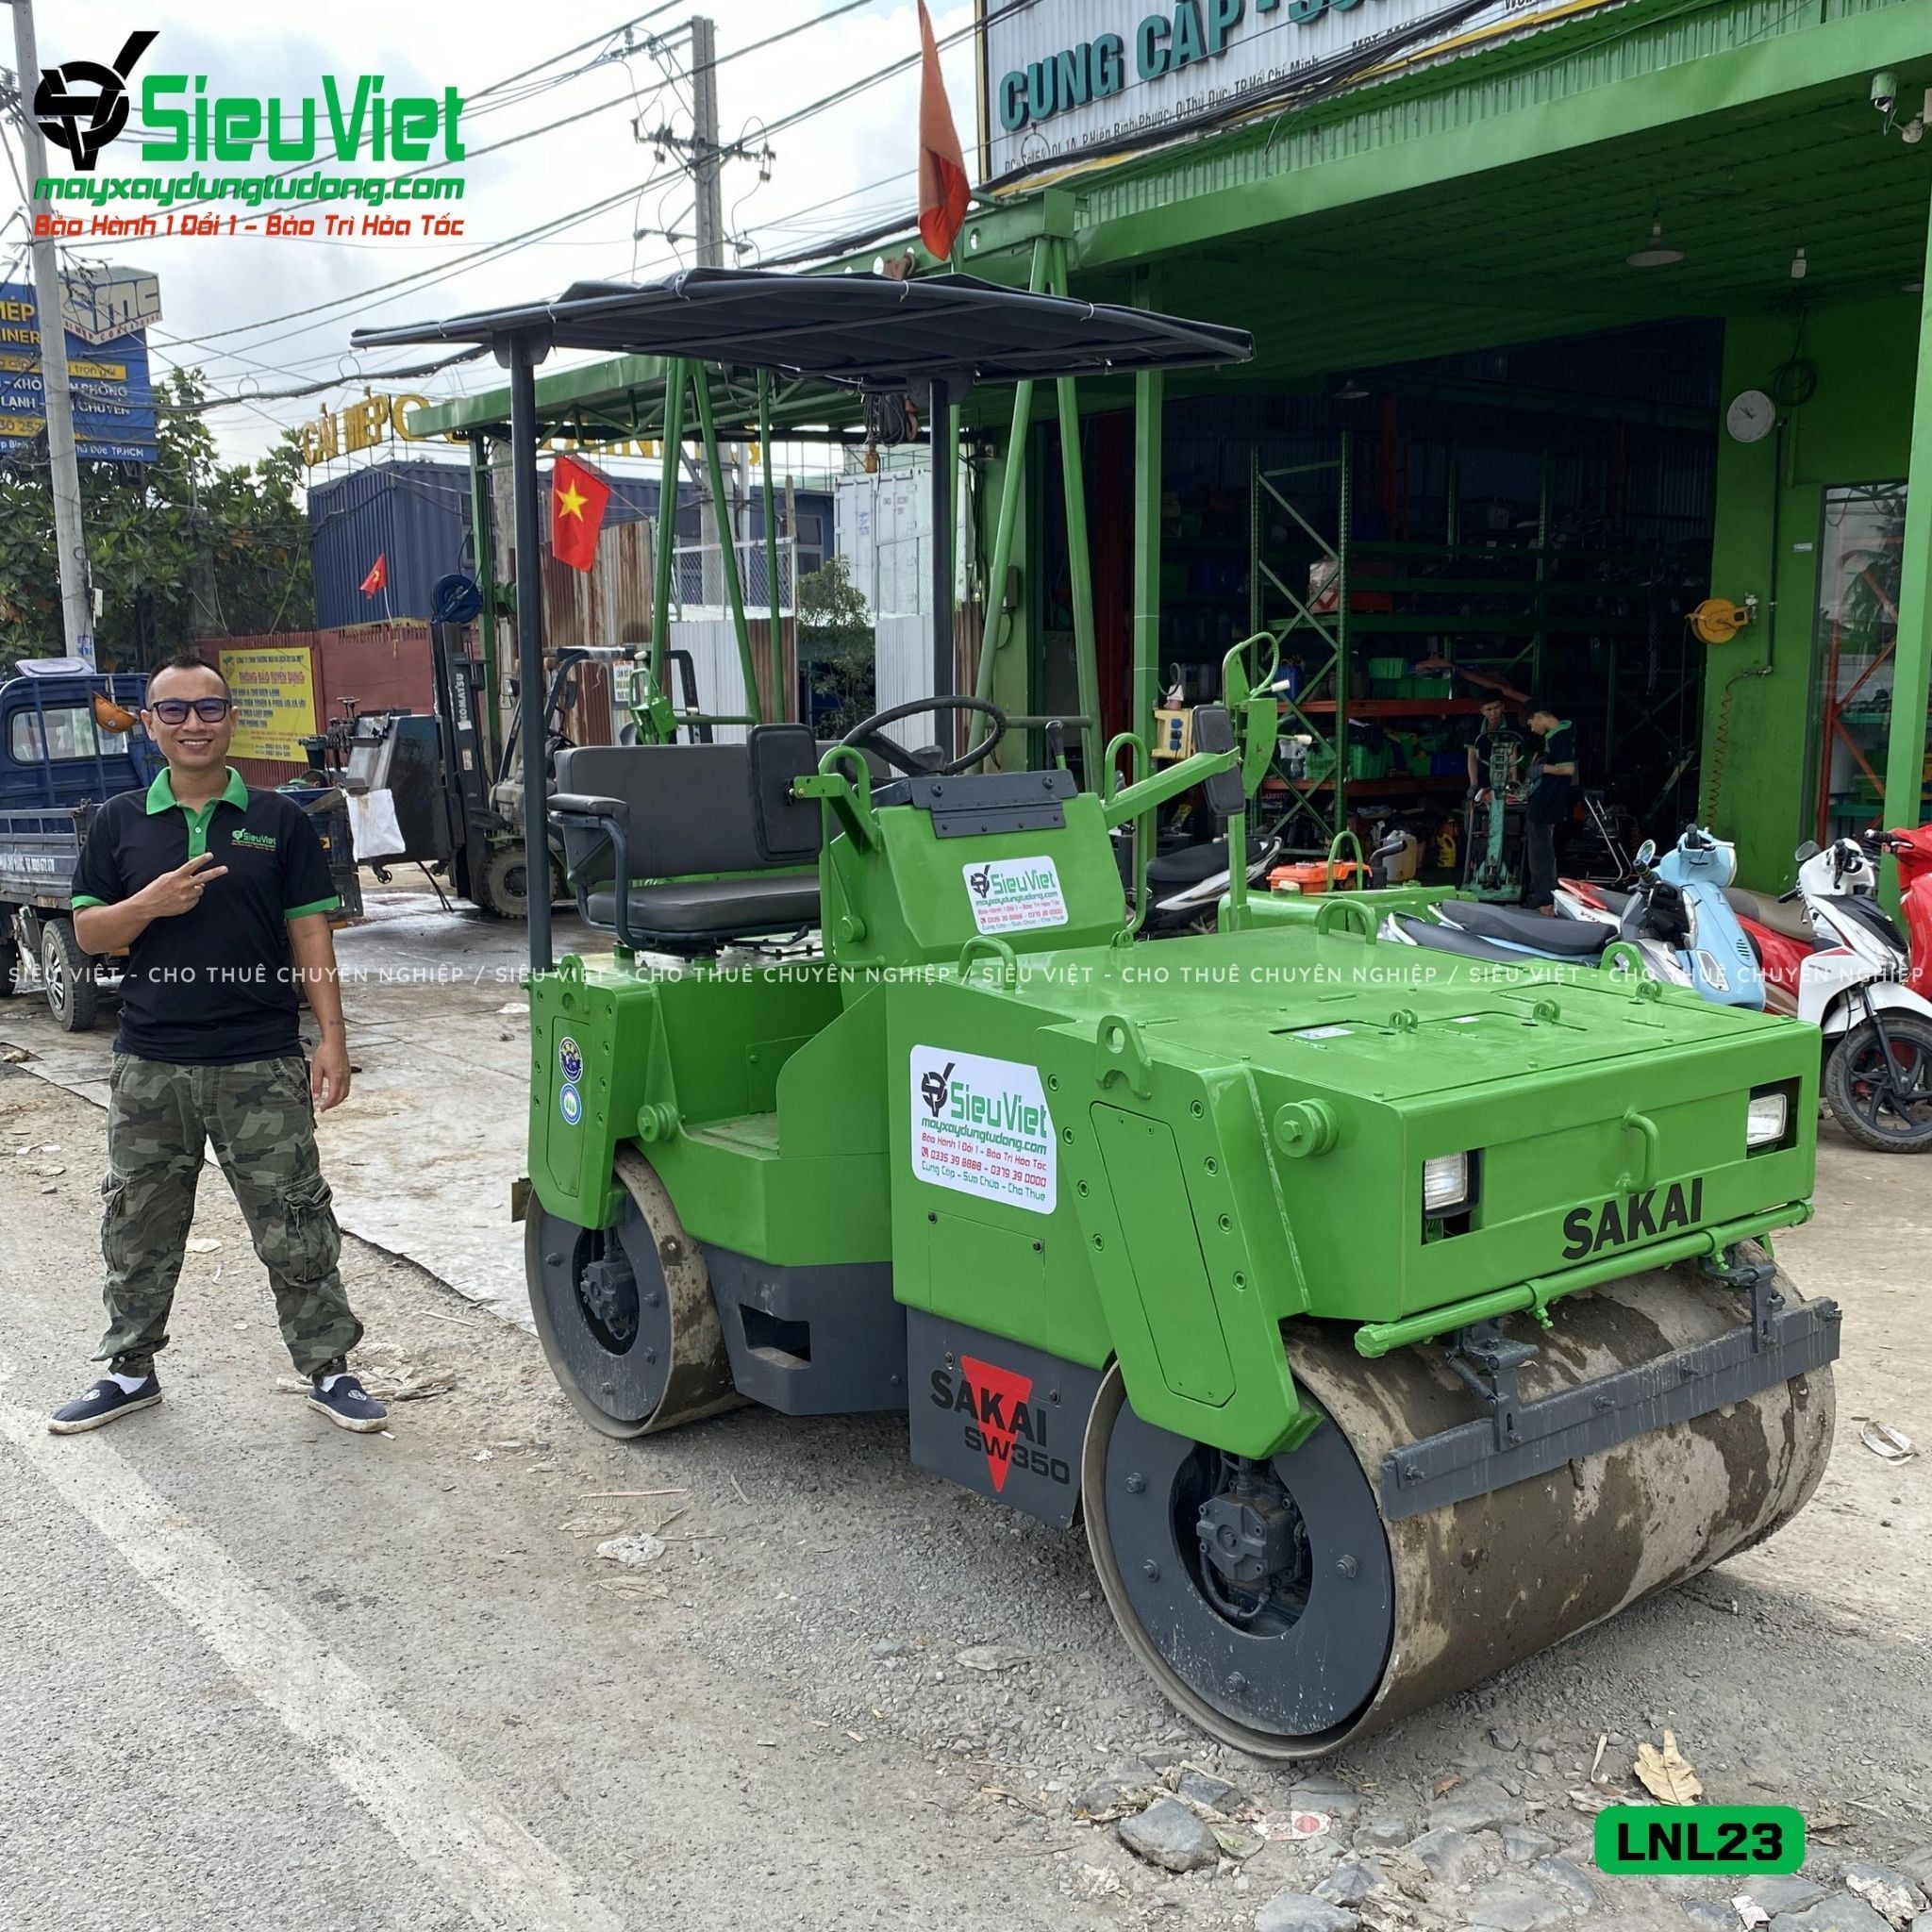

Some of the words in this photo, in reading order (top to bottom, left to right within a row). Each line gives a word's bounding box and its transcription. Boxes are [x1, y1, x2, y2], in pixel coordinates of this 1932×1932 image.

[999, 32, 1124, 131] CUNG
[991, 870, 1056, 895] SieuViet
[922, 1117, 1047, 1156] mayxaydungtudong.com
[951, 1081, 1047, 1139] SieuViet
[1561, 1177, 1703, 1260] SAKAI
[930, 1370, 1047, 1448] SAKAI
[964, 1425, 1071, 1485] SW350
